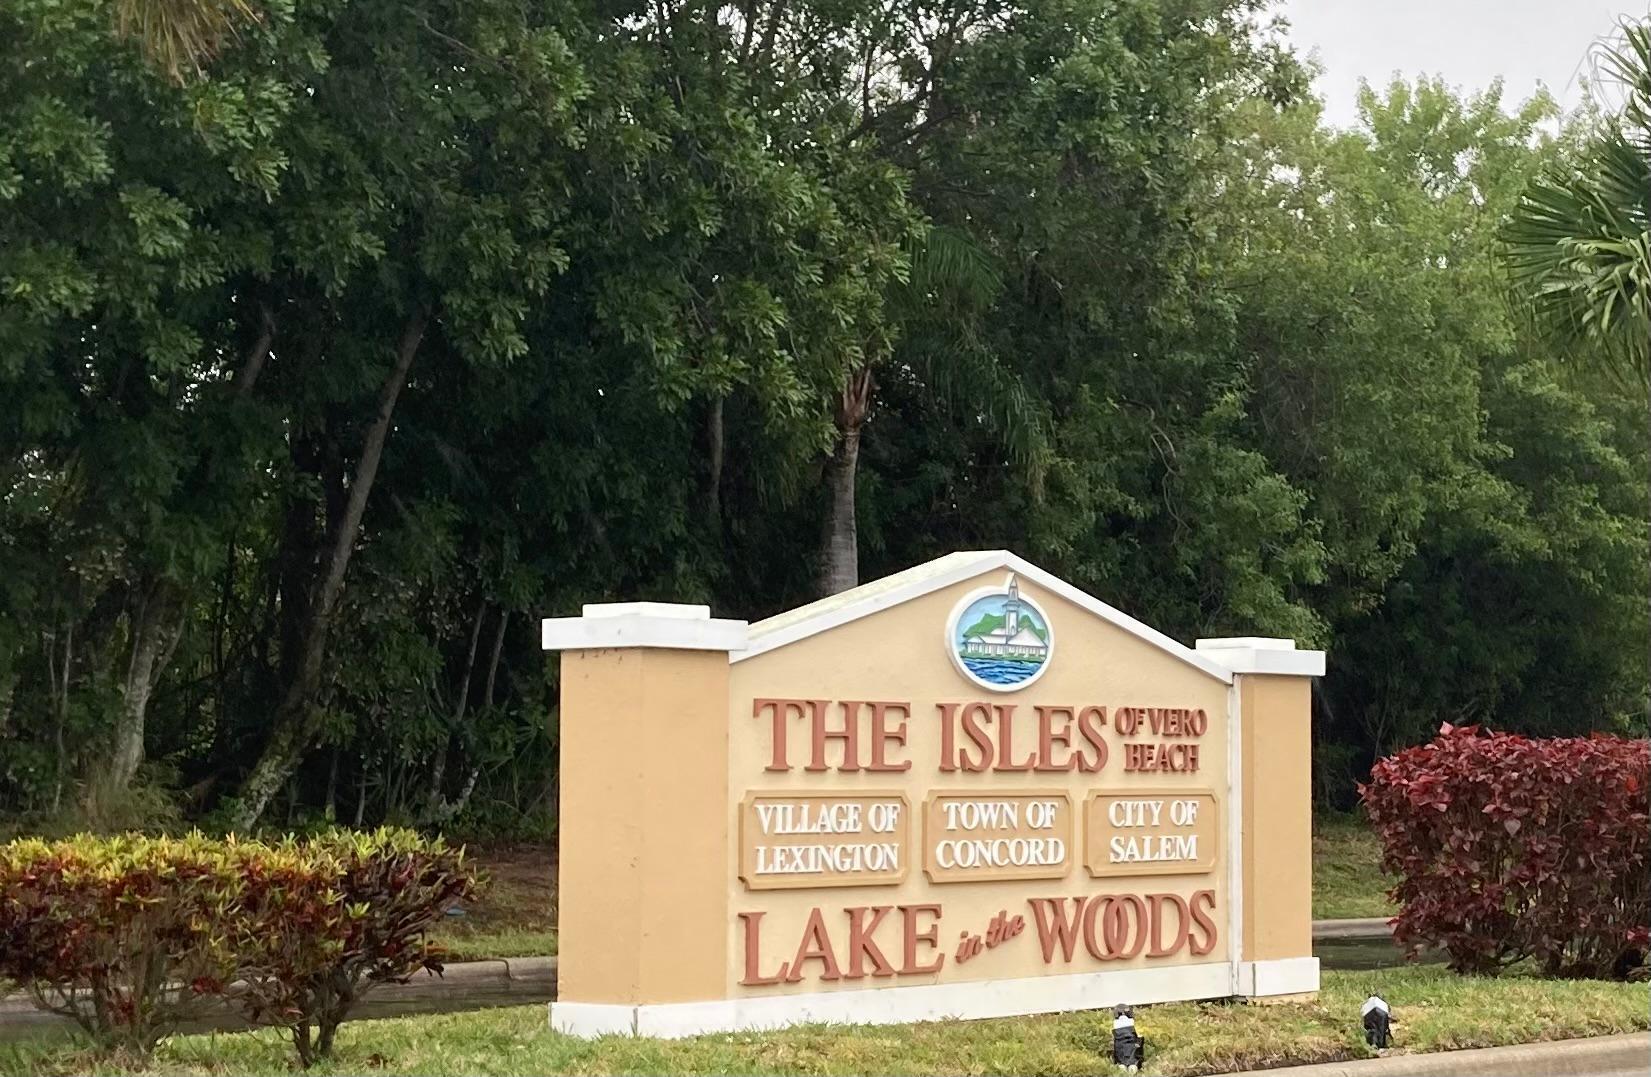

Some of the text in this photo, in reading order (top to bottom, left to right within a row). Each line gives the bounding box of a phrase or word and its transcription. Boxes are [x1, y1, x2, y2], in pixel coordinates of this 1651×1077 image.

[753, 697, 1109, 773] THE ISLES
[1115, 707, 1207, 737] OF VERO
[1124, 743, 1200, 772] BEACH
[754, 803, 900, 835] VILLAGE OF
[943, 801, 1058, 831] TOWN OF
[1108, 800, 1199, 828] CITY OF
[755, 842, 899, 874] LEXINGTON
[935, 837, 1065, 868] CONCORD
[1109, 835, 1197, 863] SALEM
[737, 889, 1217, 986] LAKE in the WOODS
